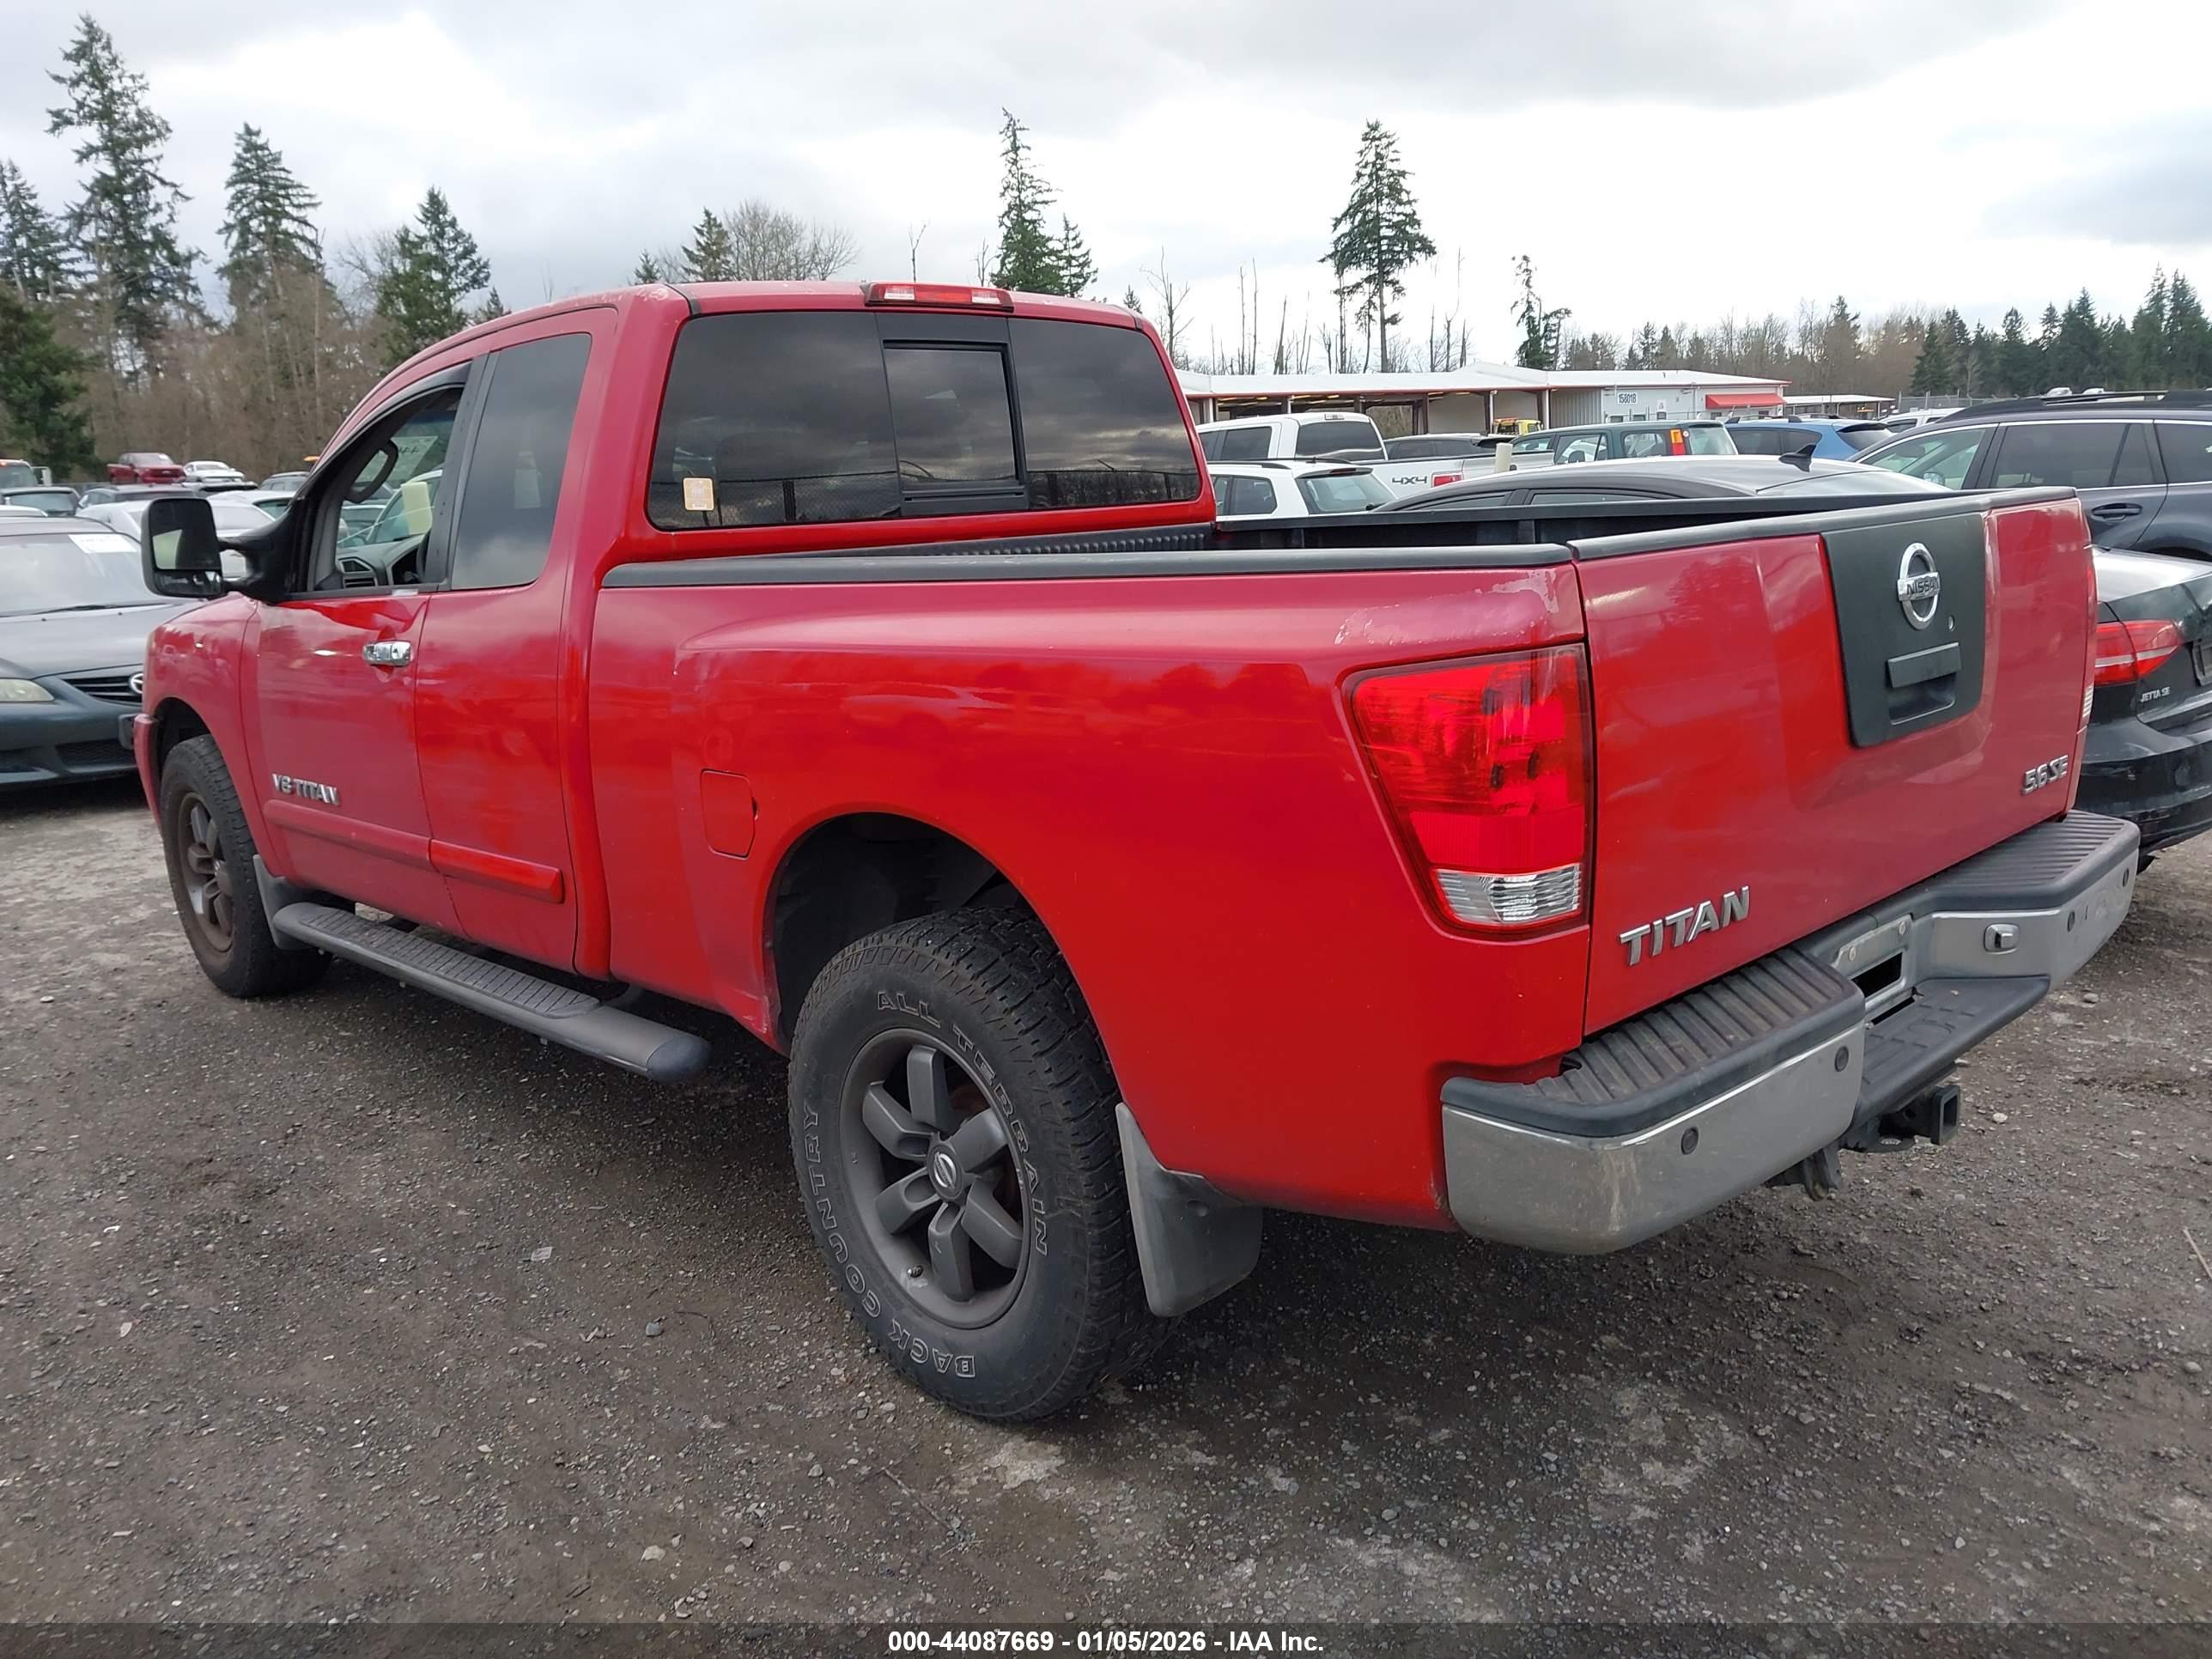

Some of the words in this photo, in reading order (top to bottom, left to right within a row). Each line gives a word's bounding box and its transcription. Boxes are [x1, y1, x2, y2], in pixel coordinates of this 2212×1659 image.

[1906, 577, 1940, 595] NISSAN
[2140, 689, 2161, 702] JETTA
[2161, 686, 2171, 697] SE
[293, 778, 340, 805] TITAN
[1619, 884, 1750, 967] TITAN
[877, 990, 941, 1030] ALL
[953, 1024, 1048, 1256] TERRAIN
[802, 1108, 882, 1319] COUNTRY
[890, 1318, 976, 1379] BACK
